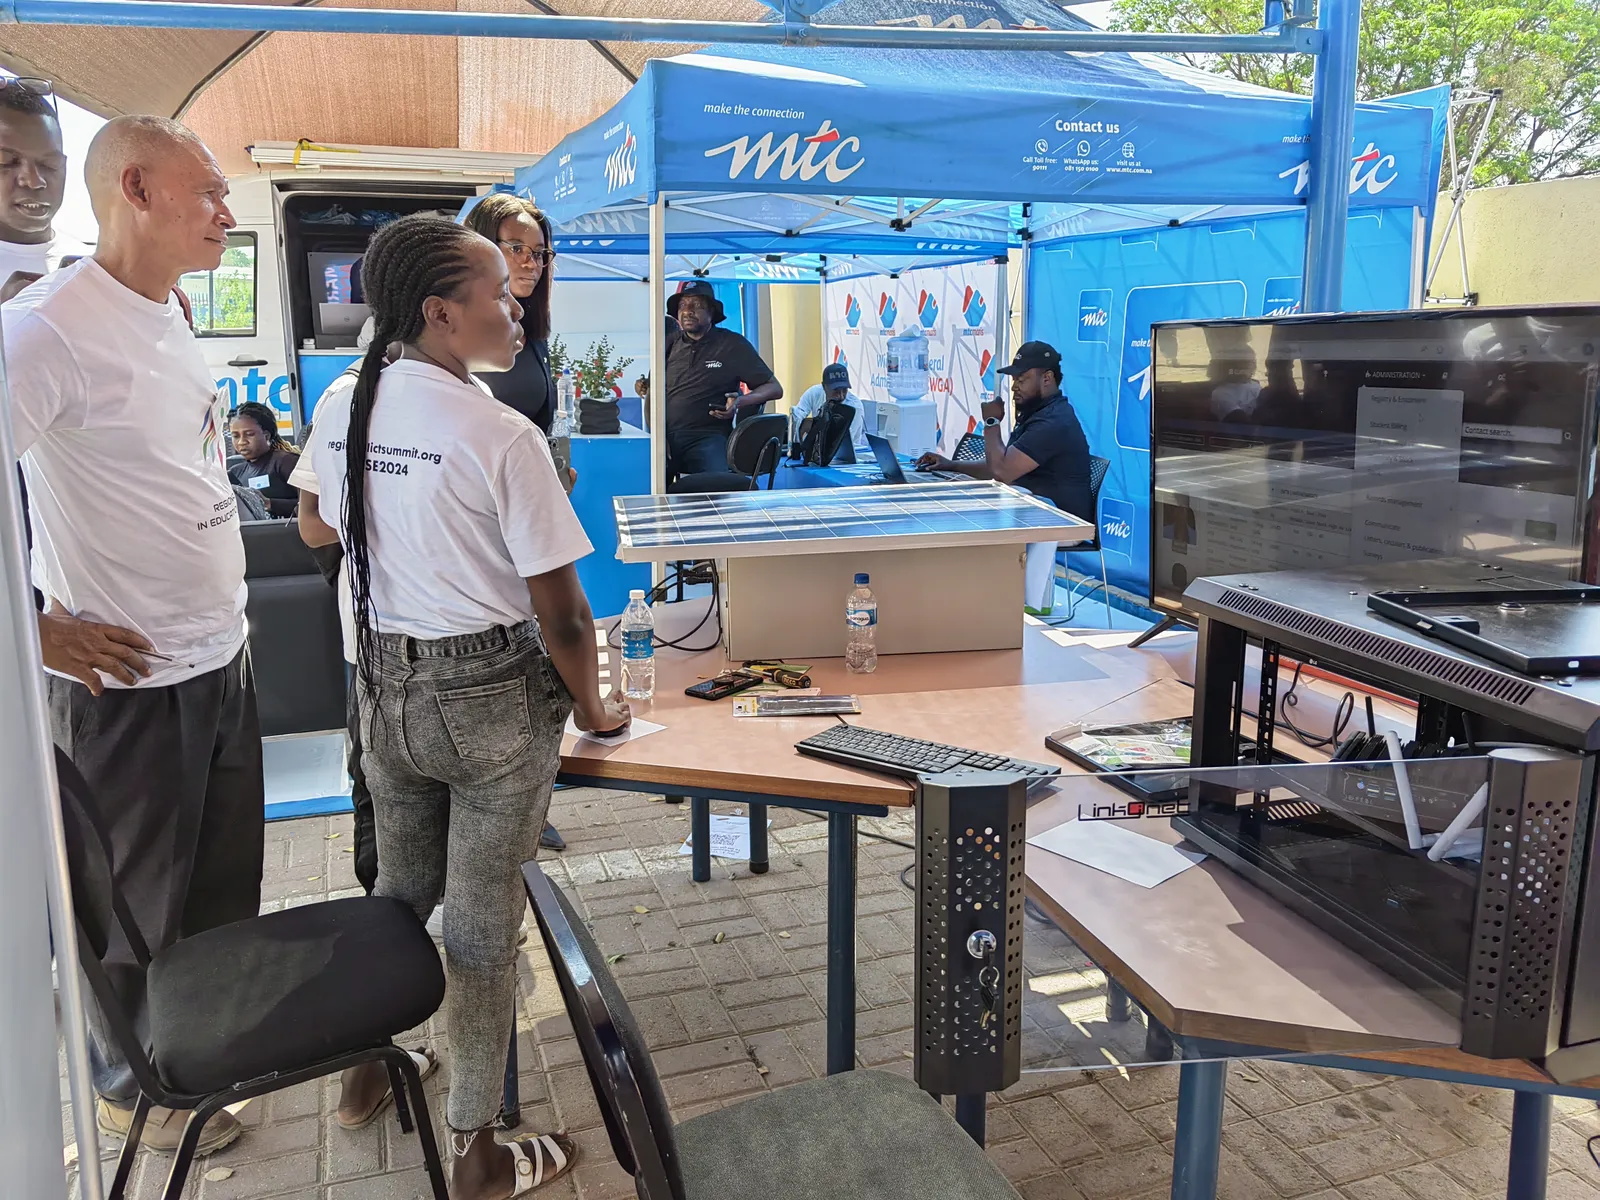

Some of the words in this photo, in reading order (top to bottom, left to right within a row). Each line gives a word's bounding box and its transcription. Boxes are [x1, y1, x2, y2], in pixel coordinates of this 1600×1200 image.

[704, 103, 732, 114] make
[734, 104, 750, 115] the
[751, 107, 805, 119] connection
[1055, 119, 1103, 133] Contact
[1106, 123, 1120, 133] us
[1282, 133, 1302, 143] make
[705, 120, 865, 183] mtc
[1022, 156, 1034, 164] Call
[1063, 158, 1091, 166] WhatsApp
[1372, 371, 1420, 379] ADMINISTRATION
[1465, 426, 1488, 435] Contact
[197, 521, 207, 530] IN
